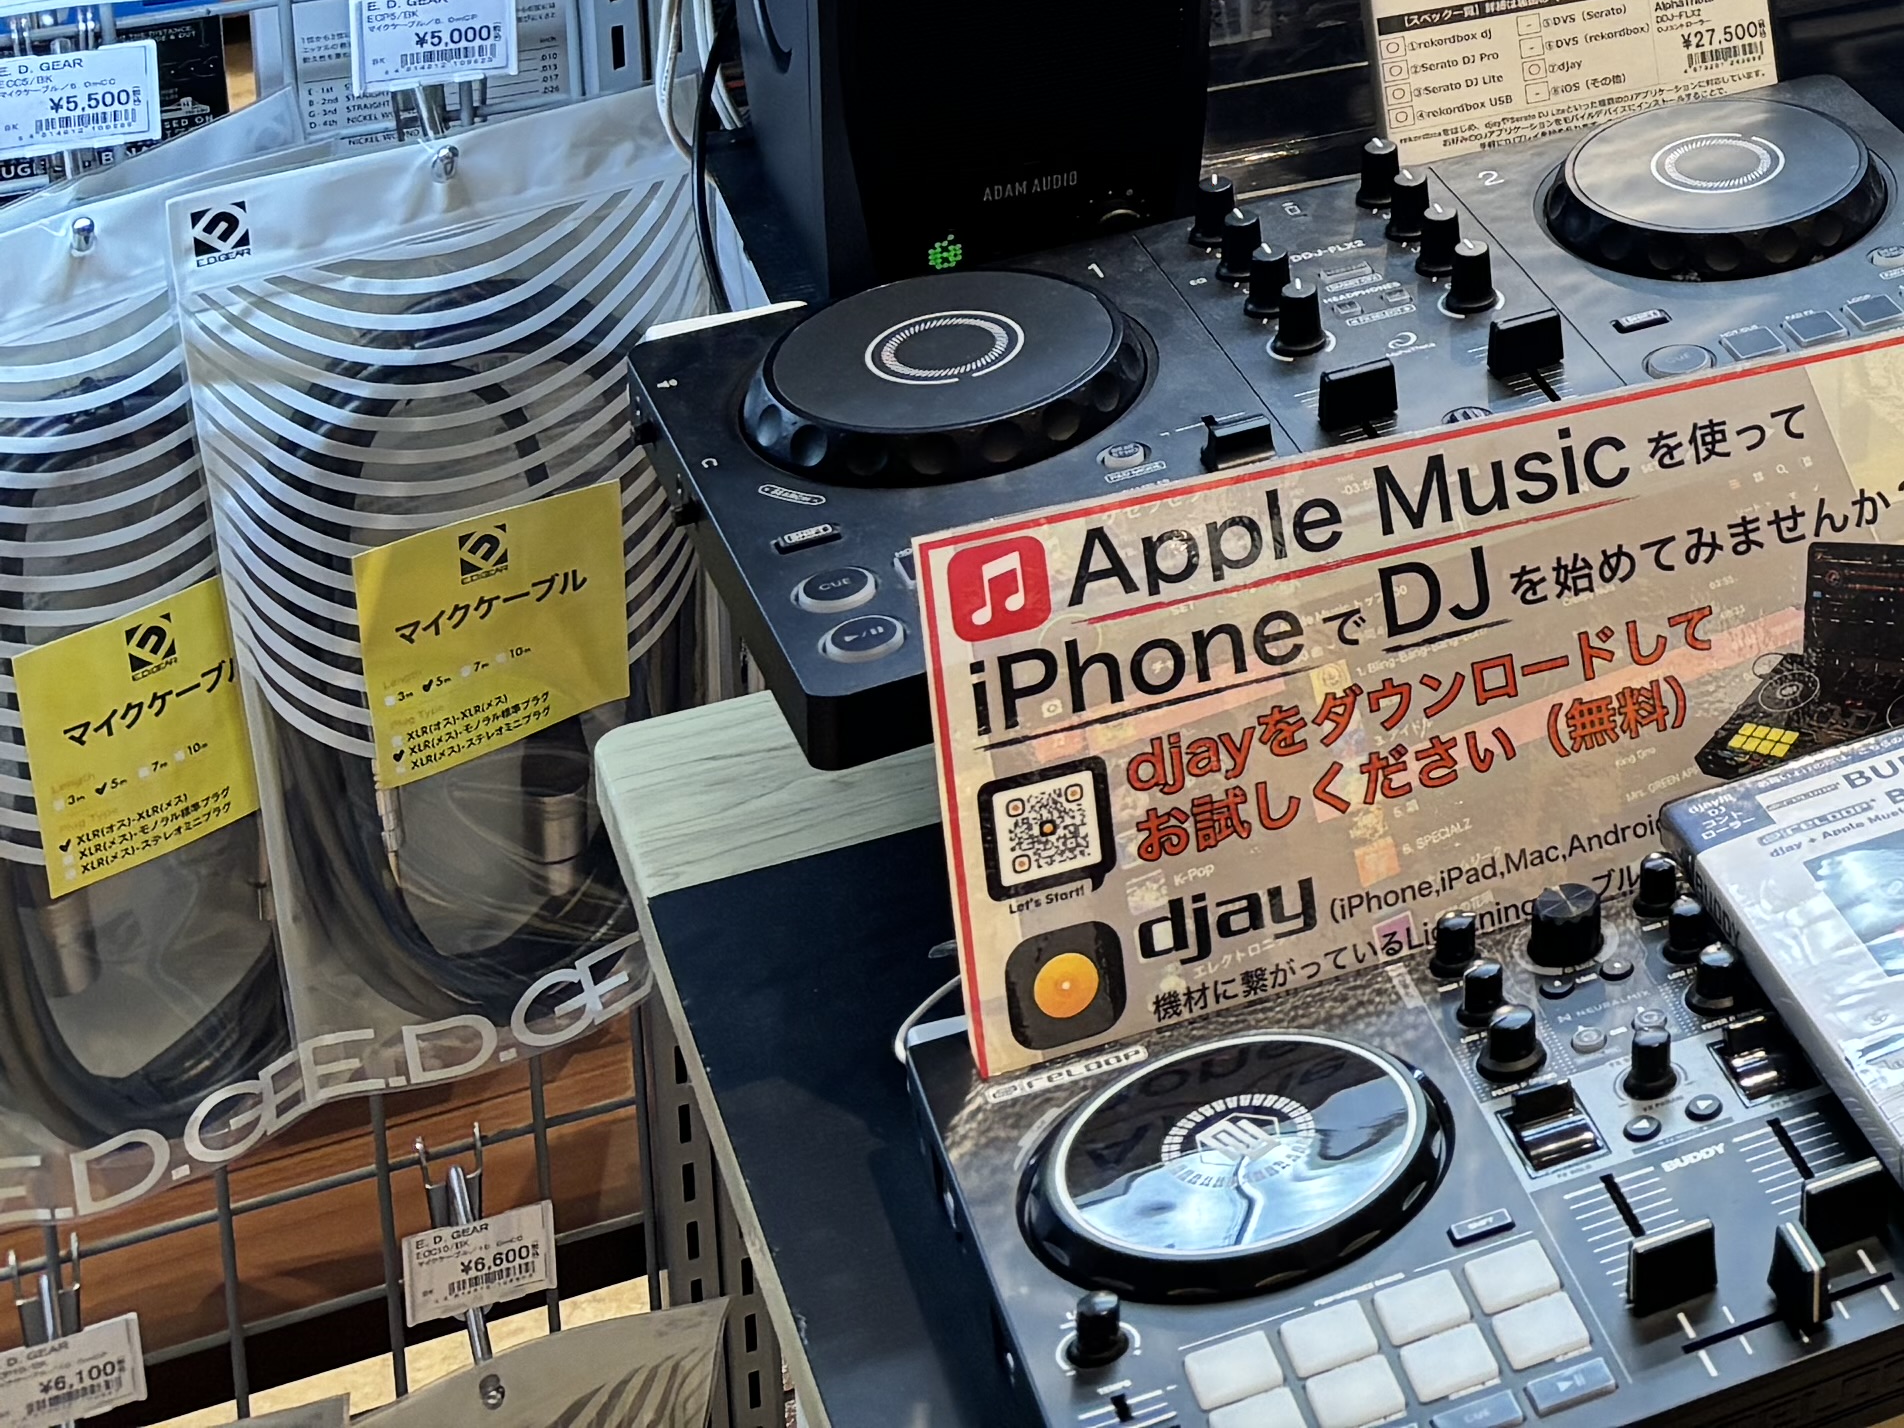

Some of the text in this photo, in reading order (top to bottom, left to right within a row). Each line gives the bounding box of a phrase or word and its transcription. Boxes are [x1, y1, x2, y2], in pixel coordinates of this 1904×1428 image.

[1069, 403, 1807, 607] Apple Music を使って
[394, 568, 588, 644] マイクケーブル
[973, 610, 1304, 737] iPhone
[1320, 616, 1367, 647] で
[1383, 544, 1491, 638] DJ
[1127, 604, 1716, 798] djayをダウンロードして
[76, 791, 189, 847] XLR(オス)-XLR(メス)
[81, 802, 232, 874] XLR(メス)-ステレオミニプラグ
[1136, 874, 1318, 966] djay
[1661, 1142, 1725, 1174] BUDDY
[461, 1245, 531, 1273] ¥6,600
[39, 1363, 117, 1392] ¥6,100
